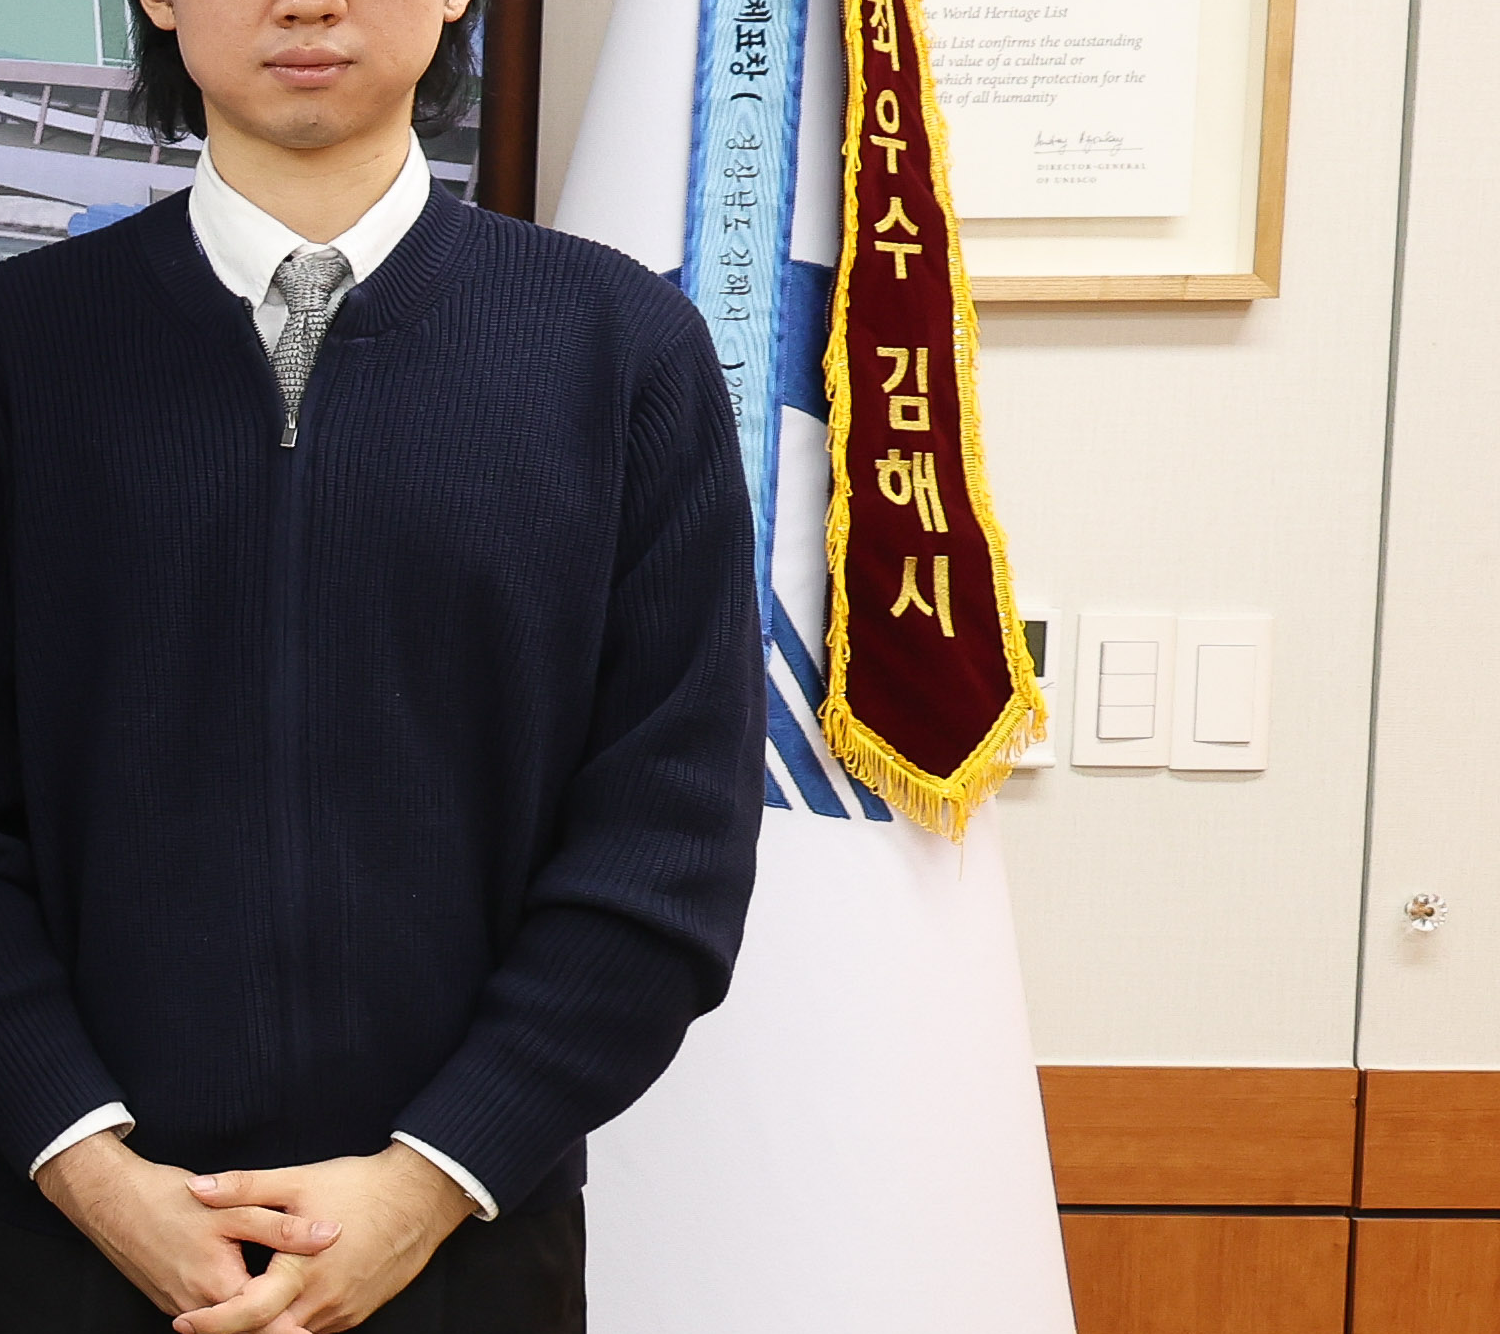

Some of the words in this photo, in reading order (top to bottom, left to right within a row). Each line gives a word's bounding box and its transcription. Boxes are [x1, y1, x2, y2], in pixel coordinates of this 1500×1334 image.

[943, 7, 981, 19] World
[983, 7, 1042, 22] Heritage
[1044, 6, 1068, 19] List
[950, 36, 975, 49] List
[978, 36, 1036, 53] confirms
[1039, 36, 1061, 48] the
[1064, 36, 1143, 50] outstanding
[947, 55, 984, 67] value
[987, 54, 1002, 72] of
[1003, 58, 1011, 67] a
[1015, 54, 1067, 66] cultural
[1070, 57, 1086, 67] or
[935, 74, 973, 86] which
[976, 74, 1029, 90] requires
[1031, 72, 1098, 88] protection
[1100, 72, 1121, 89] for
[1124, 71, 1146, 83] the
[957, 91, 971, 107] of
[972, 91, 990, 103] all
[992, 91, 1057, 107] humanity
[1036, 163, 1147, 171] DIRECTOR-GENERAL
[722, 130, 764, 235] 경상남도
[1036, 176, 1050, 184] OF
[1054, 176, 1097, 184] UNESCO
[715, 246, 753, 323] 김해시
[875, 344, 956, 645] 김해시
